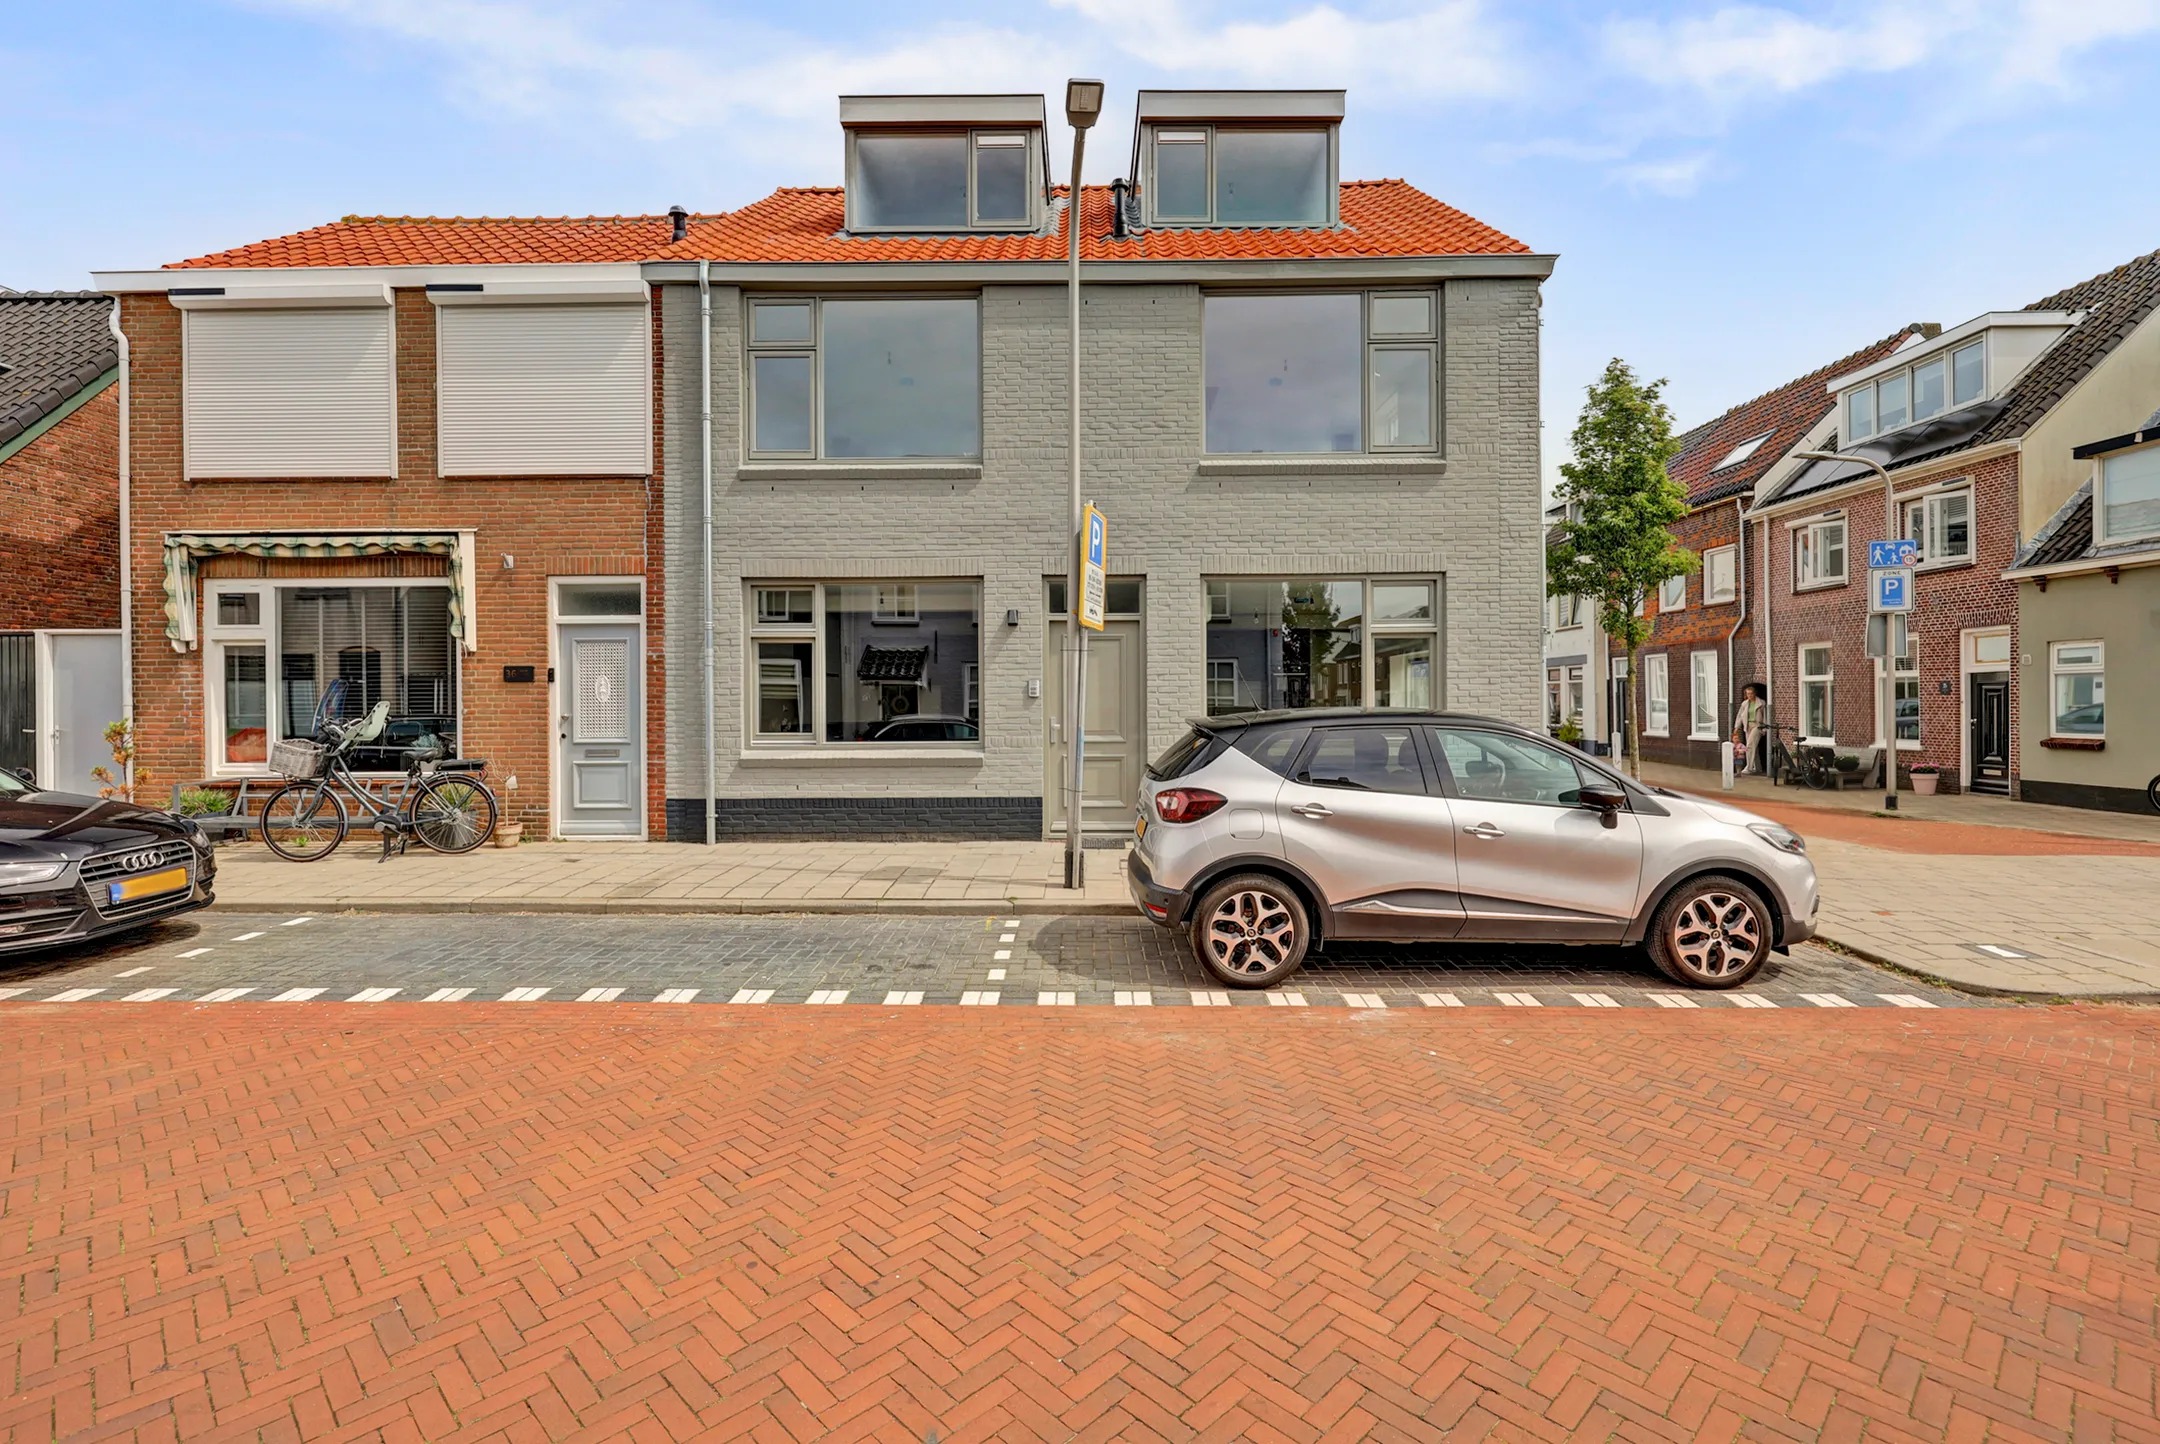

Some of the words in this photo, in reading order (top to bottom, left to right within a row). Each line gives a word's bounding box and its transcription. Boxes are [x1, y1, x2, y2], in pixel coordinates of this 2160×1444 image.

[1092, 520, 1100, 558] P
[1885, 580, 1898, 595] P
[506, 670, 517, 678] 36
